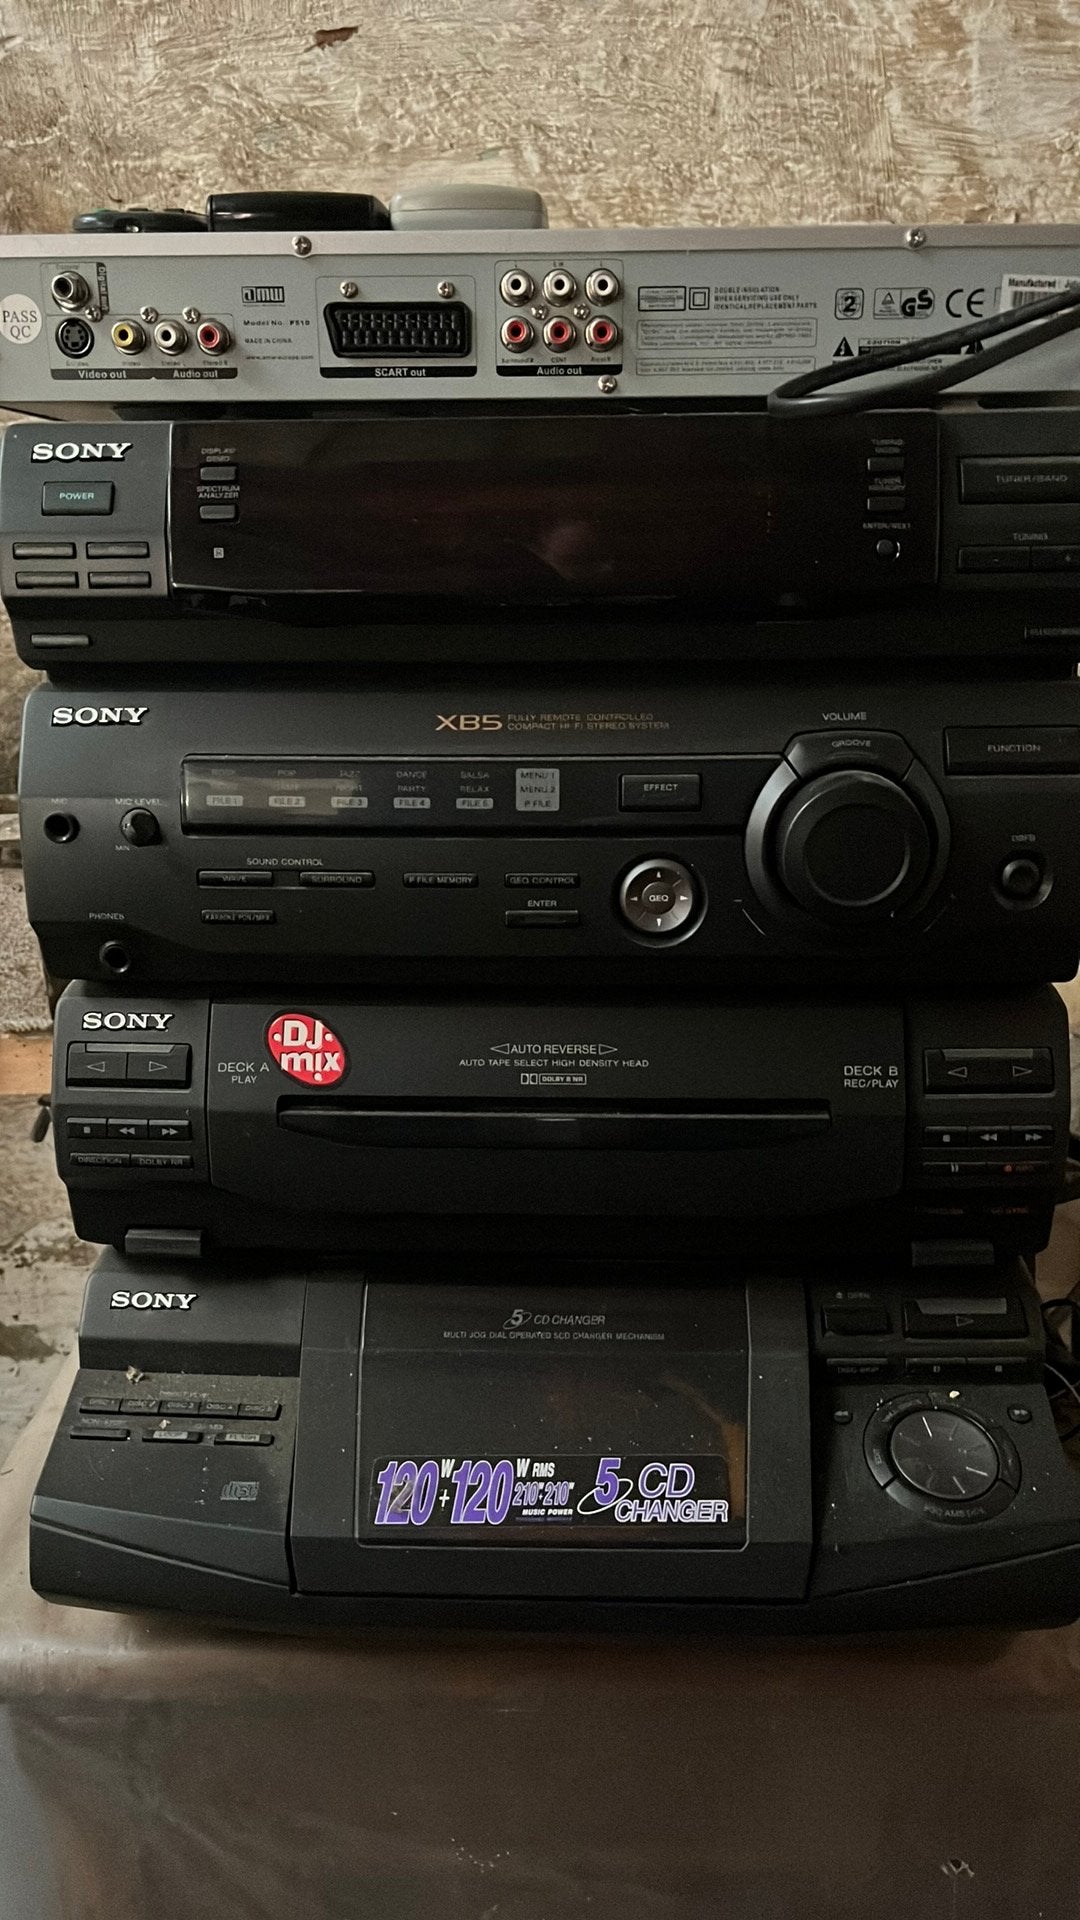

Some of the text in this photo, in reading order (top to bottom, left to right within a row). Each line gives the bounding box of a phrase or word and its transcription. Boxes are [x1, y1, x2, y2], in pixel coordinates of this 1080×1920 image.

[842, 296, 856, 312] 2
[901, 289, 932, 316] GS
[946, 289, 984, 318] CE
[3, 311, 38, 324] PASS
[10, 325, 32, 340] QC
[78, 369, 126, 379] Video out
[172, 369, 218, 379] Audio out
[375, 368, 426, 378] SCART out
[537, 366, 583, 375] Audio out
[31, 442, 133, 462] SONY
[59, 492, 95, 500] POWER
[52, 707, 149, 726] SONY
[586, 713, 654, 721] CONTROLLED
[822, 712, 867, 721] VOLUME
[435, 713, 503, 731] XB5
[507, 723, 555, 731] COMPACT
[587, 722, 626, 730] STEREO
[629, 721, 670, 730] SYSTEM
[831, 739, 872, 748] GROOVE
[987, 744, 1041, 752] FUNCTION
[396, 771, 427, 779] DANCE
[460, 771, 490, 779] SALSA
[520, 771, 549, 779] MENU
[398, 785, 426, 793] PARTY
[460, 785, 490, 793] RELAX
[520, 786, 548, 794] MENU
[643, 783, 678, 792] EFFECT
[114, 798, 161, 806] MIC LEVEL
[532, 800, 551, 808] FILE
[247, 858, 324, 866] SOUND CONTROL
[312, 875, 363, 883] SURROUND
[437, 876, 473, 884] MEMORY
[531, 876, 576, 884] CONTROL
[527, 899, 557, 907] ENTER
[88, 911, 125, 920] PHONES
[82, 1012, 173, 1031] SONY
[282, 1019, 325, 1049] DJ
[510, 1044, 597, 1054] AUTO REVERSE
[218, 1062, 270, 1072] DECK A
[459, 1059, 649, 1067] AUTO TAPE SELECT HIGH DENSITY HEAD
[843, 1065, 899, 1075] DECK B
[231, 1075, 257, 1084] PLAY
[843, 1079, 899, 1088] REC/PLAY
[110, 1290, 199, 1310] SONY
[512, 1308, 606, 1326] 5 CD CHANGER
[443, 1331, 467, 1339] MULTI
[469, 1331, 486, 1339] JOG
[509, 1331, 551, 1340] OPERATED
[573, 1332, 612, 1340] CHANGER
[615, 1332, 665, 1340] MECHANISM
[594, 1457, 622, 1504] 5
[638, 1462, 696, 1499] CD
[374, 1460, 439, 1525] 120
[441, 1458, 455, 1478] W
[451, 1460, 514, 1525] 120
[516, 1458, 531, 1478] W
[532, 1462, 556, 1478] RMS
[522, 1508, 574, 1516] MUSIC POWER
[614, 1499, 729, 1523] CHANGER
